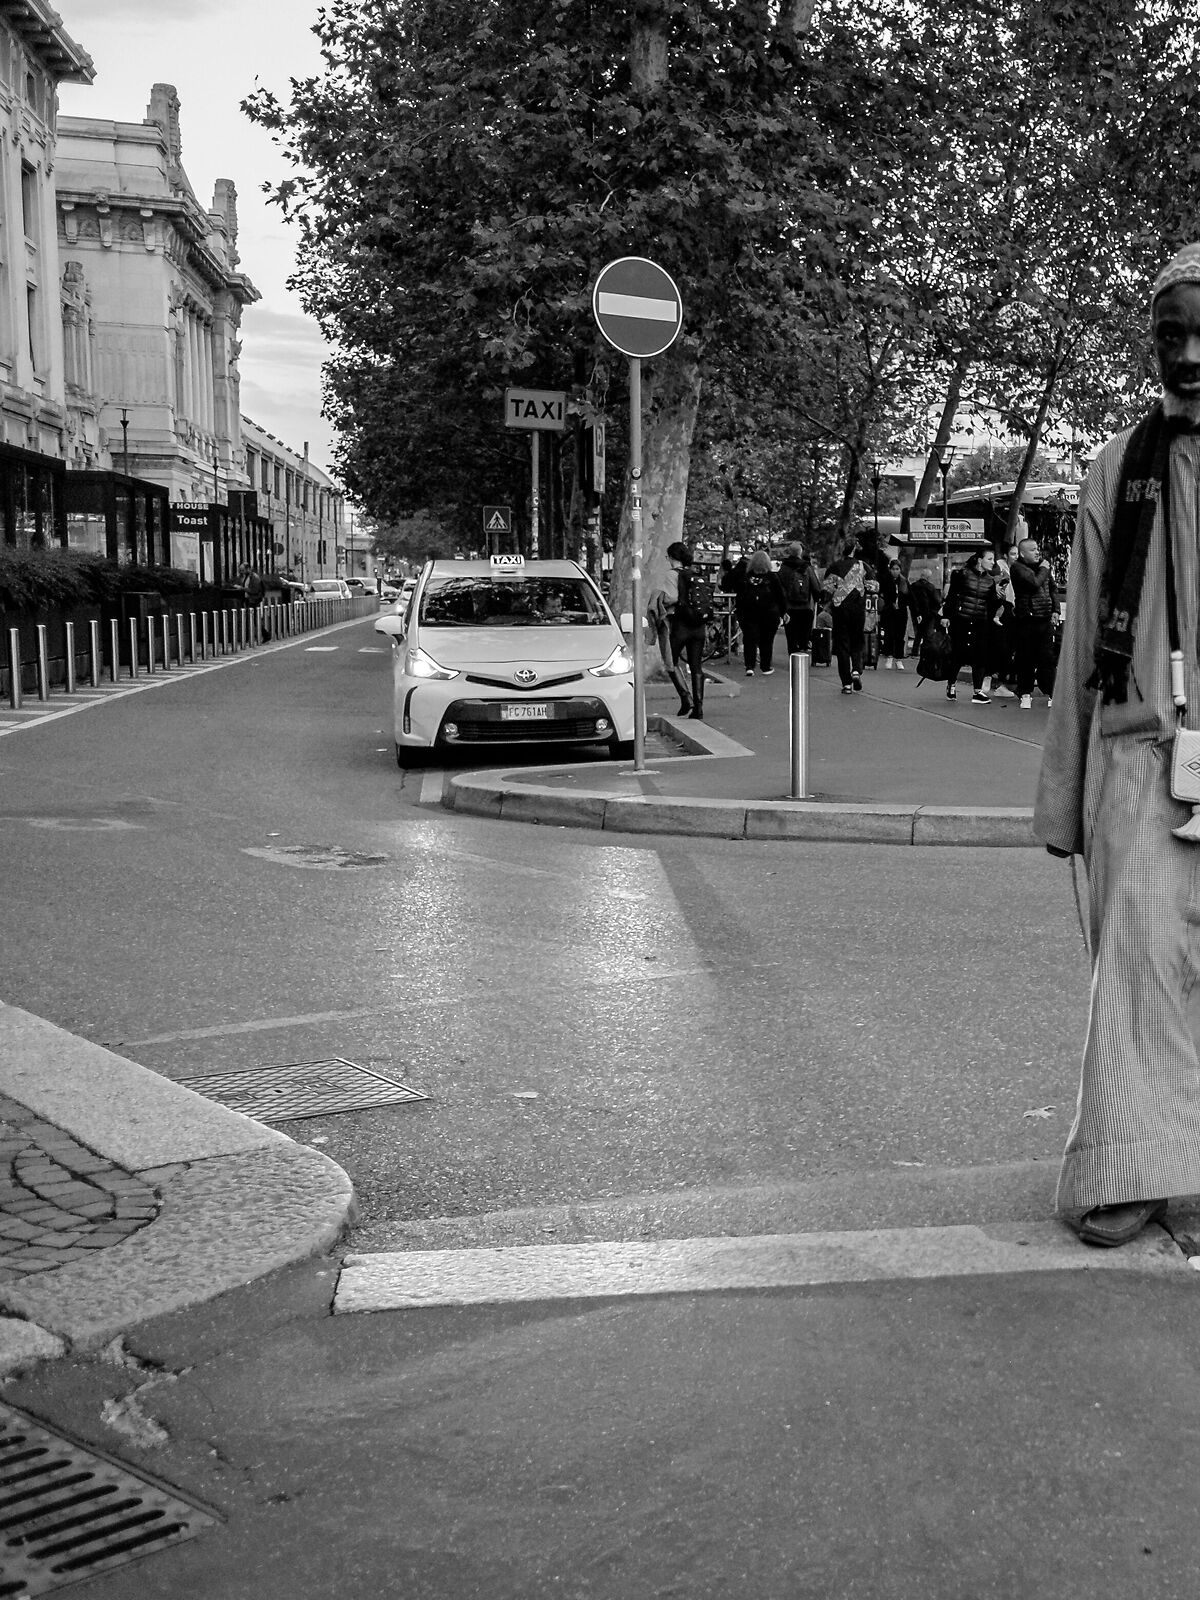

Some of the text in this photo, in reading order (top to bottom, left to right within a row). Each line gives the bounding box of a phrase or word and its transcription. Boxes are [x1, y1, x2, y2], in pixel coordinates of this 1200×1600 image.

[510, 398, 563, 420] TAXI
[176, 502, 210, 511] HOUSE
[177, 514, 208, 526] Toast
[493, 555, 521, 565] TAXI
